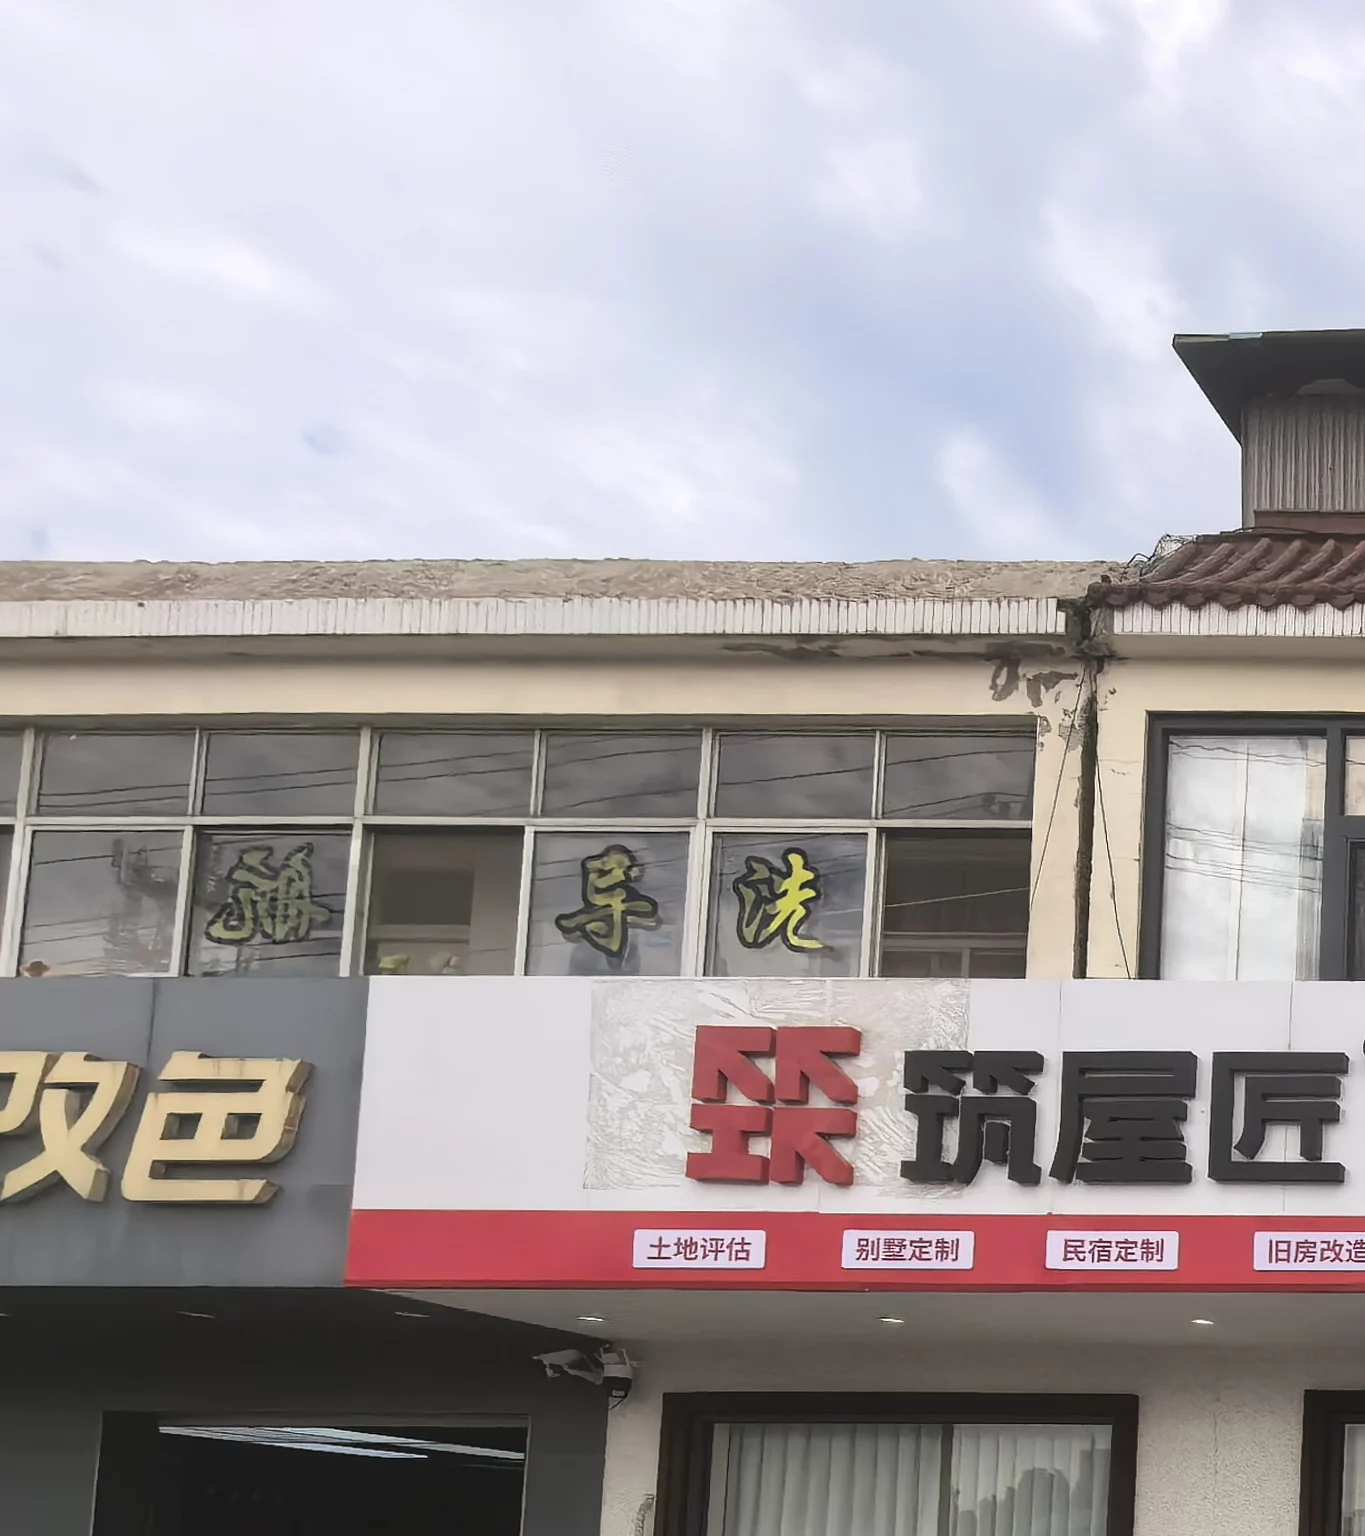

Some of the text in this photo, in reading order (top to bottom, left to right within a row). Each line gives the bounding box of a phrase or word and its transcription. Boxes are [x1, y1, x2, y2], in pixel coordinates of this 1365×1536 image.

[900, 1050, 1350, 1184] 筑屋匠
[647, 1237, 751, 1261] 土地评估
[856, 1238, 959, 1262] 别墅定制
[1063, 1239, 1164, 1263] 民宿定制
